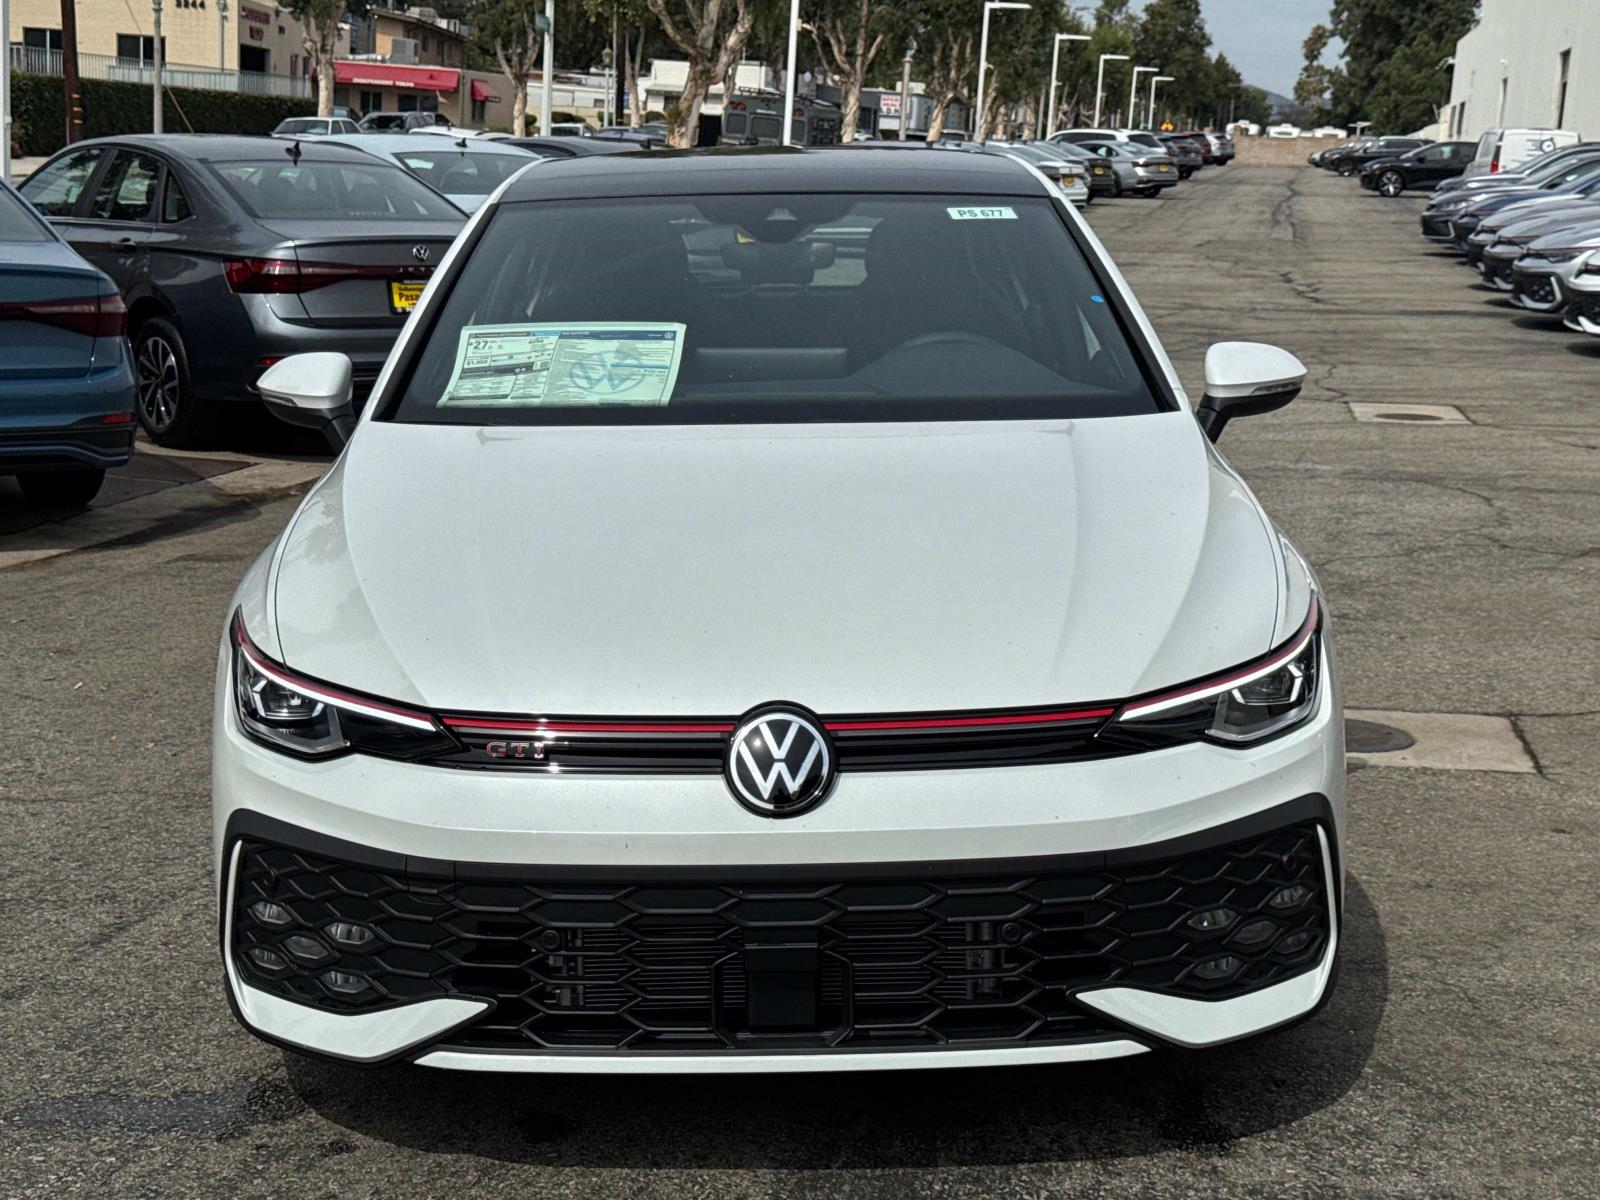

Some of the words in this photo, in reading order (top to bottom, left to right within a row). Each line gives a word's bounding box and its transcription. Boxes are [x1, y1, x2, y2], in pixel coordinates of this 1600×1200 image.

[957, 209, 978, 218] PS
[980, 209, 1003, 217] 677
[473, 340, 489, 350] 27
[485, 740, 545, 760] GTI
